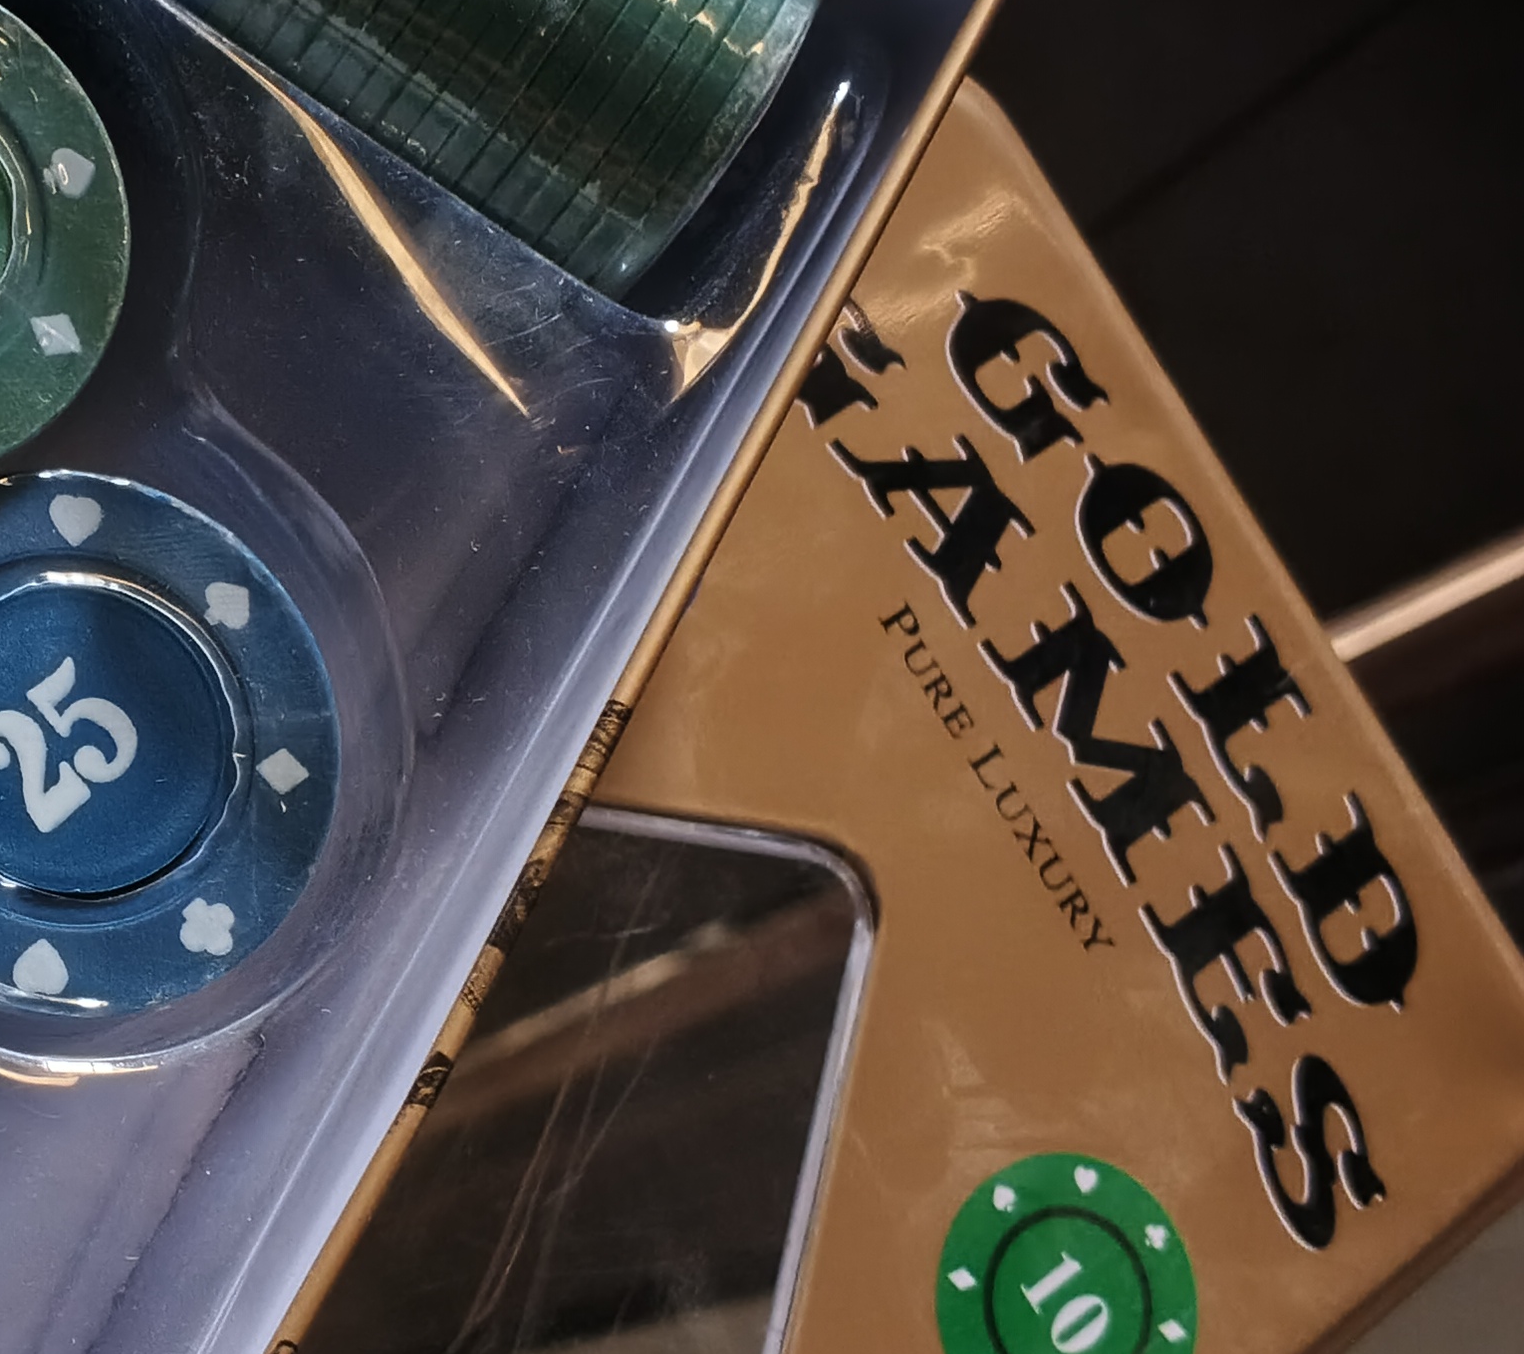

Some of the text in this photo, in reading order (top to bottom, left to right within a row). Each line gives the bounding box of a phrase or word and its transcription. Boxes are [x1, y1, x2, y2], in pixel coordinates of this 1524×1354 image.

[878, 600, 1117, 953] PURE LUXURY
[944, 289, 1419, 1013] GOLD
